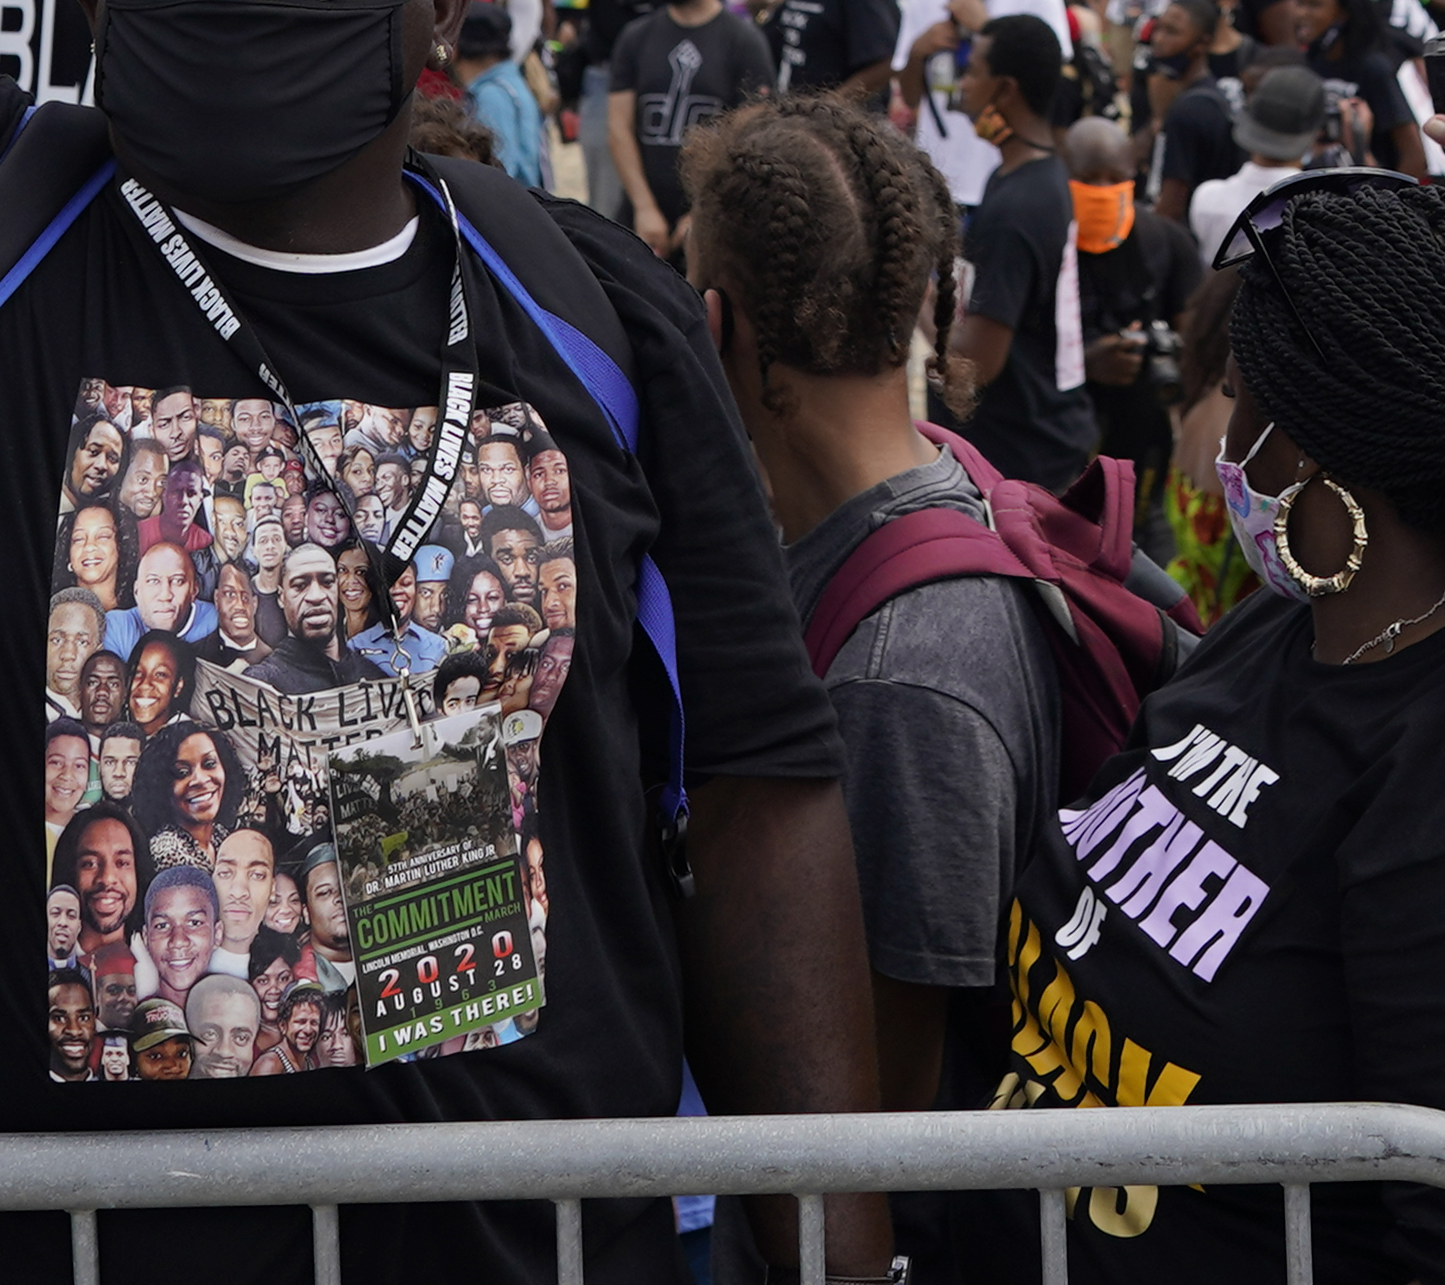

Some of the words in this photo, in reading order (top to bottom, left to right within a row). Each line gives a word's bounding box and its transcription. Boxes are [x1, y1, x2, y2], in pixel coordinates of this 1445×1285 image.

[120, 177, 176, 245] MATTER
[159, 232, 206, 287] LIVES
[194, 275, 241, 341] BLACK
[443, 372, 474, 424] BLACK
[433, 425, 468, 481] LIVES
[389, 479, 455, 562] MATTER
[205, 684, 319, 732] BLACK
[1150, 723, 1228, 782] I'M
[1191, 744, 1281, 830] THE
[365, 879, 382, 895] DR.
[384, 869, 422, 888] MARTIN
[423, 858, 459, 879] LUTHER
[461, 848, 484, 863] KING
[484, 844, 496, 856] JR
[388, 860, 408, 874] 57TH
[409, 844, 461, 869] ANNIVERSARY
[462, 839, 473, 852] OF
[353, 903, 374, 919] THE
[356, 870, 516, 950] COMMITMENT
[484, 901, 522, 923] MARCH
[1055, 884, 1109, 962] OF
[362, 955, 391, 974] LINCOLN
[427, 931, 471, 952] WASHINGTON
[378, 930, 514, 999] 2020
[375, 969, 476, 1018] AUGUST
[493, 953, 523, 977] 28
[410, 979, 497, 1020] 1963
[378, 1033, 387, 1053] I
[393, 1015, 445, 1047] WAS
[449, 983, 535, 1028] THERE!
